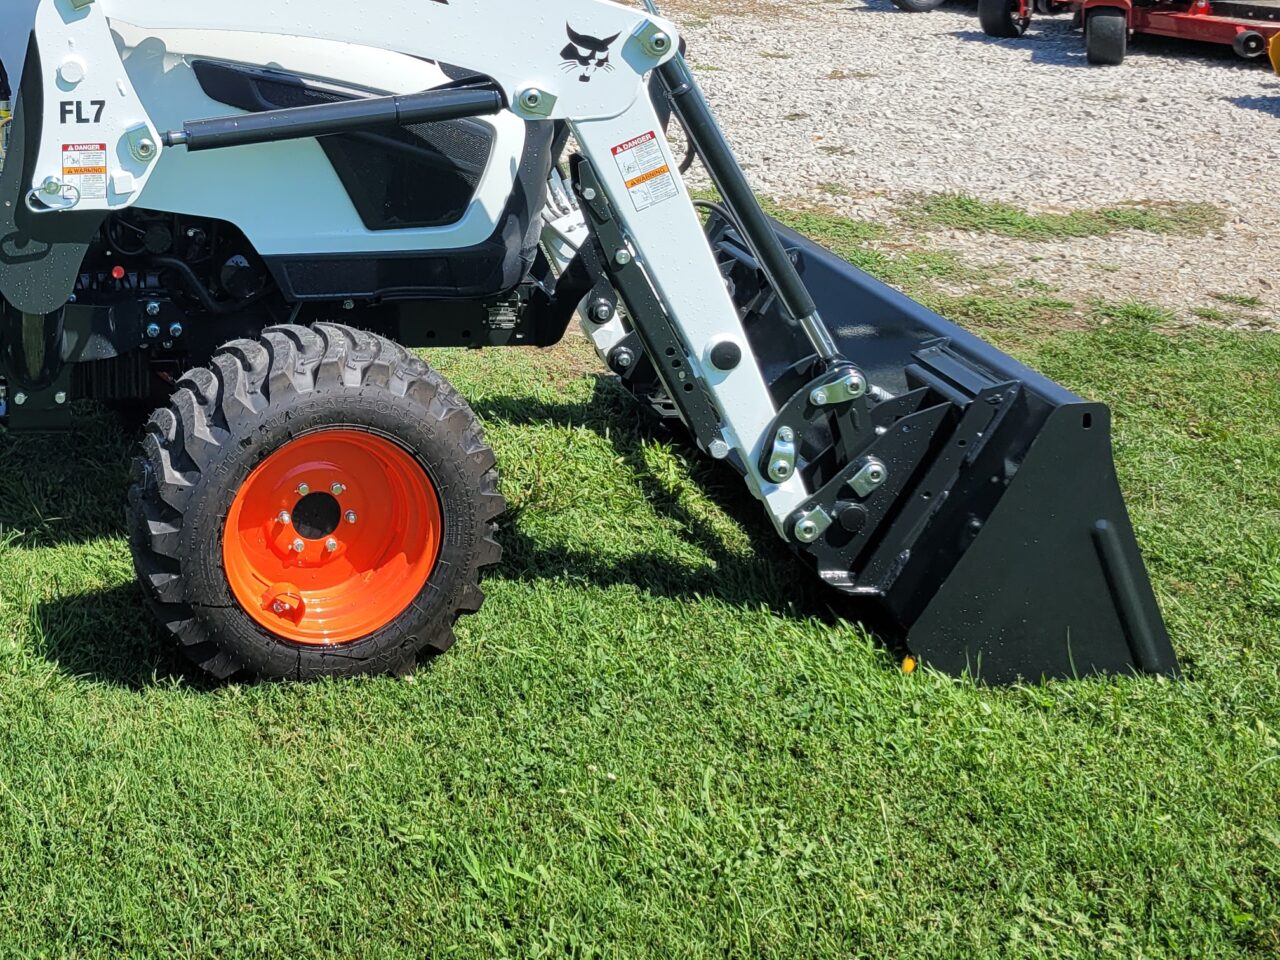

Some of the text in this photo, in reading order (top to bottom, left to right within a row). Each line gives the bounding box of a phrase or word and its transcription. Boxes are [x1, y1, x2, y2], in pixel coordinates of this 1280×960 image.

[60, 100, 106, 124] FL7
[623, 133, 652, 150] DANGER
[637, 167, 666, 184] WARNING
